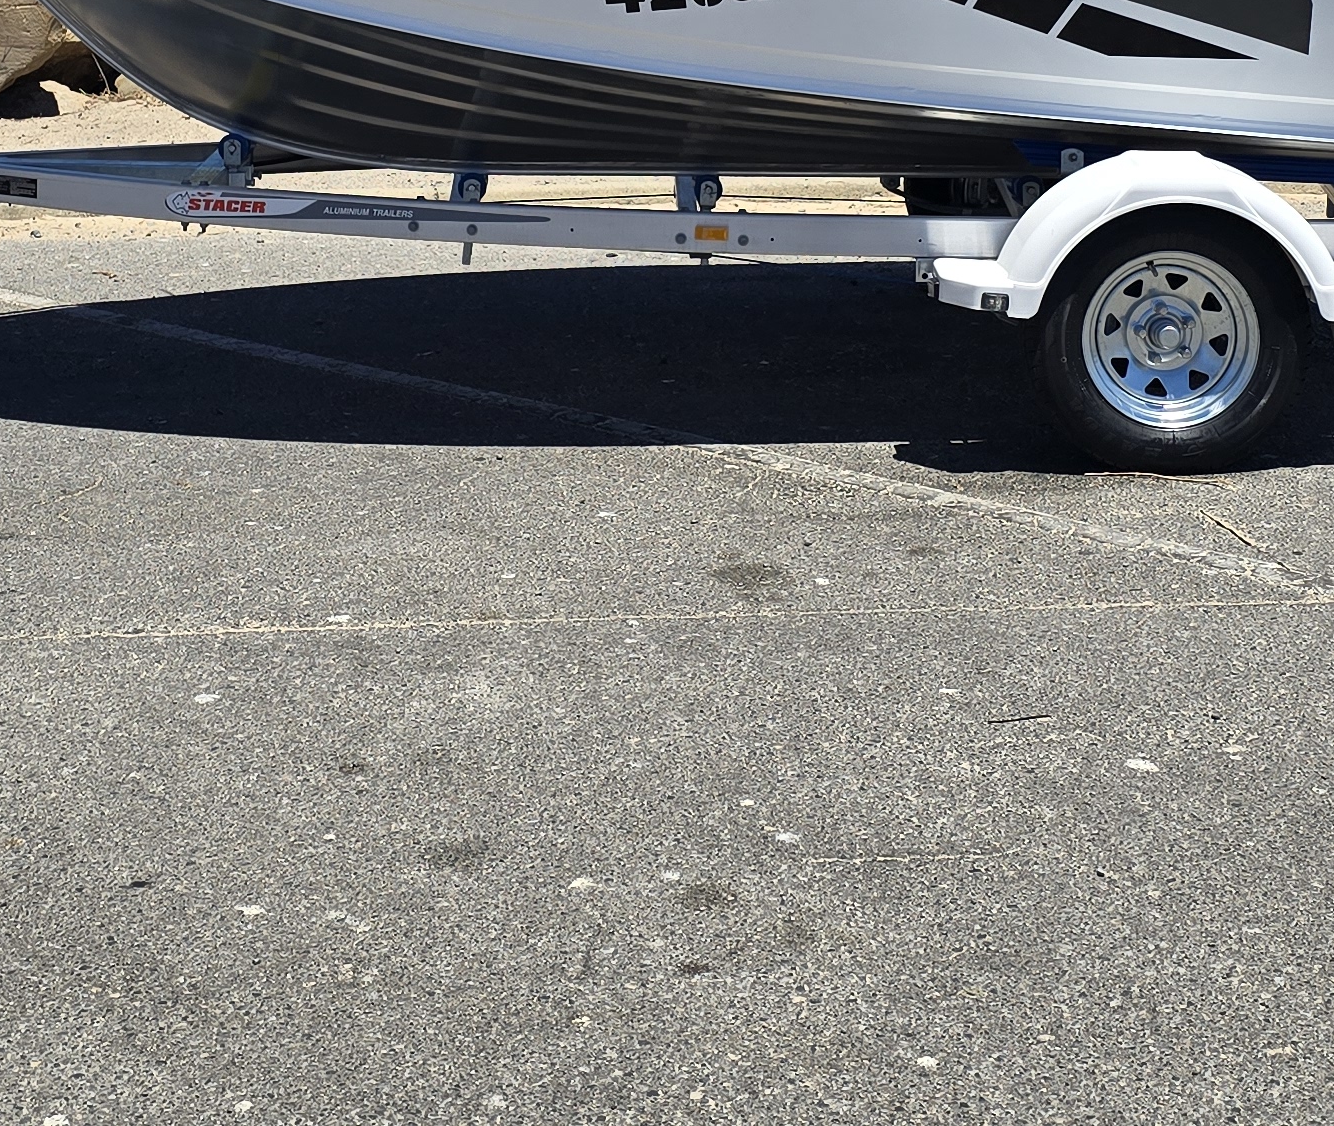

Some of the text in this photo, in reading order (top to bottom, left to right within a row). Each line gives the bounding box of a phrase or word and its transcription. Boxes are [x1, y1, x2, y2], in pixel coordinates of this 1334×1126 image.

[188, 198, 267, 214] STACER
[323, 206, 414, 218] ALUMINIUM TRAILERS
